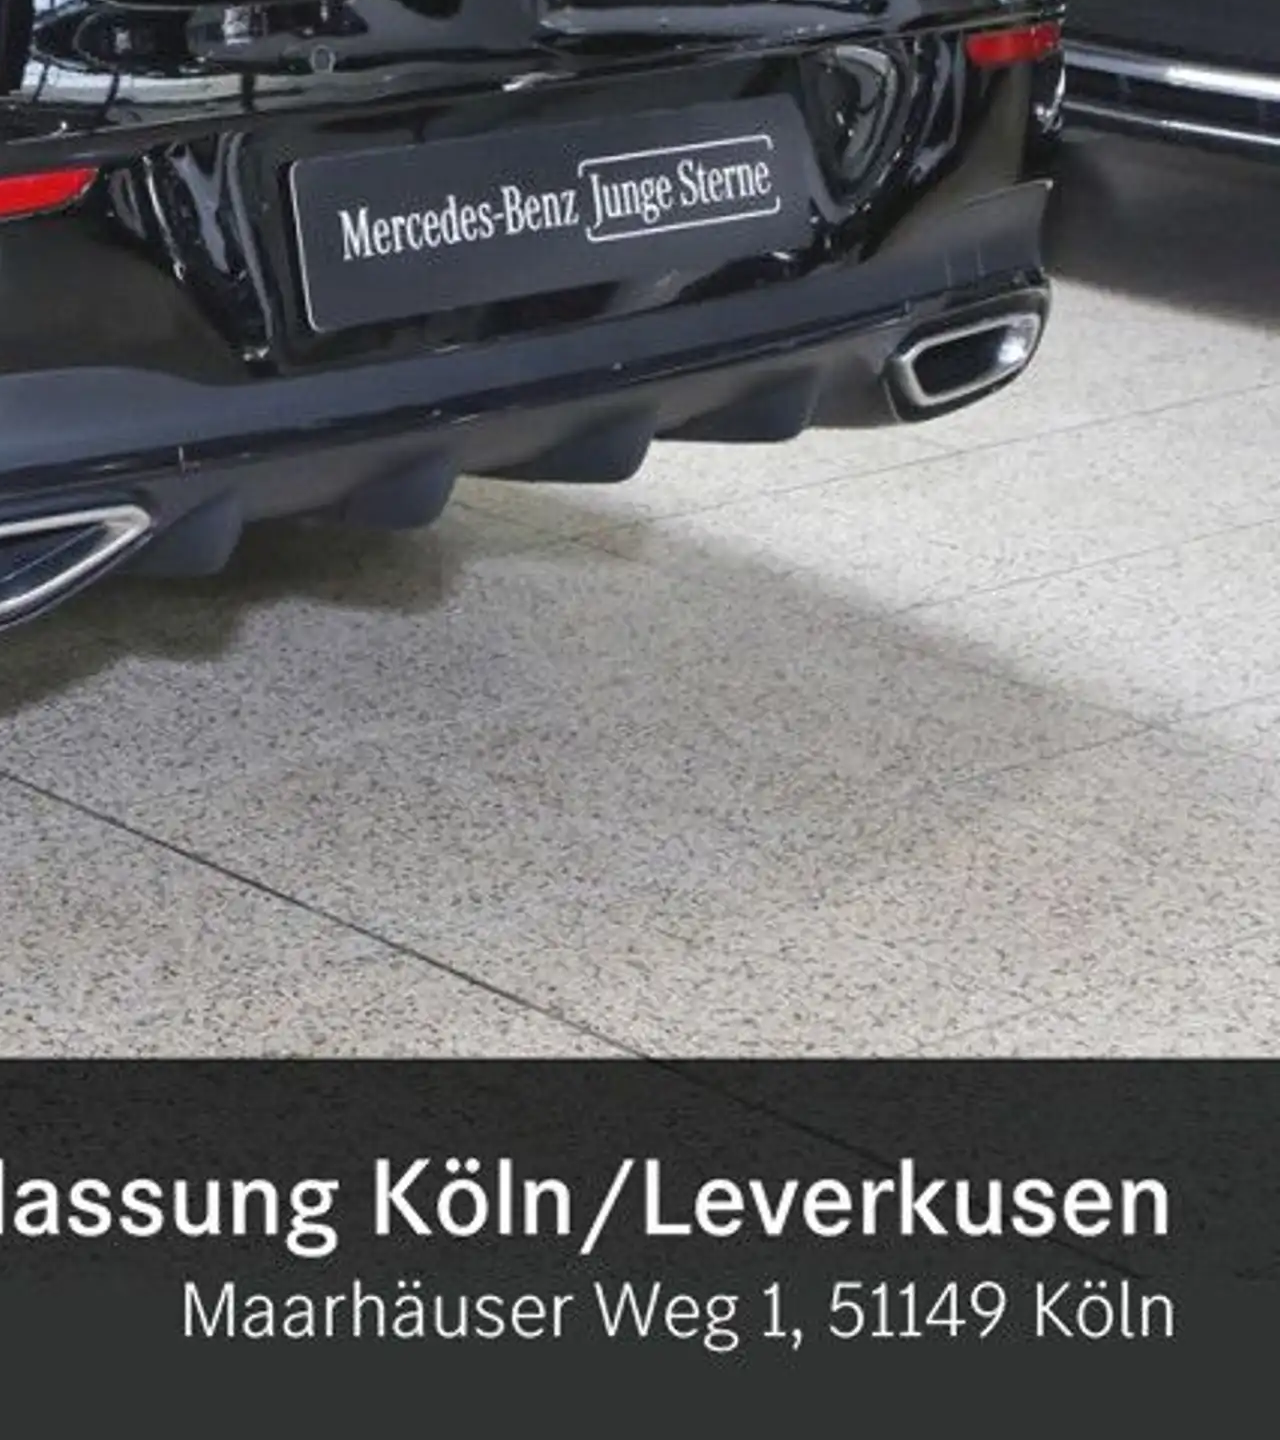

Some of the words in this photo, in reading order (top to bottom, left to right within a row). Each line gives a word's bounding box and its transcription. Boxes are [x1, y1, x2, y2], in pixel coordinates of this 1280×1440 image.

[338, 184, 581, 261] Mercedes-Benz
[587, 171, 674, 228] Junge
[673, 157, 773, 208] Sterne
